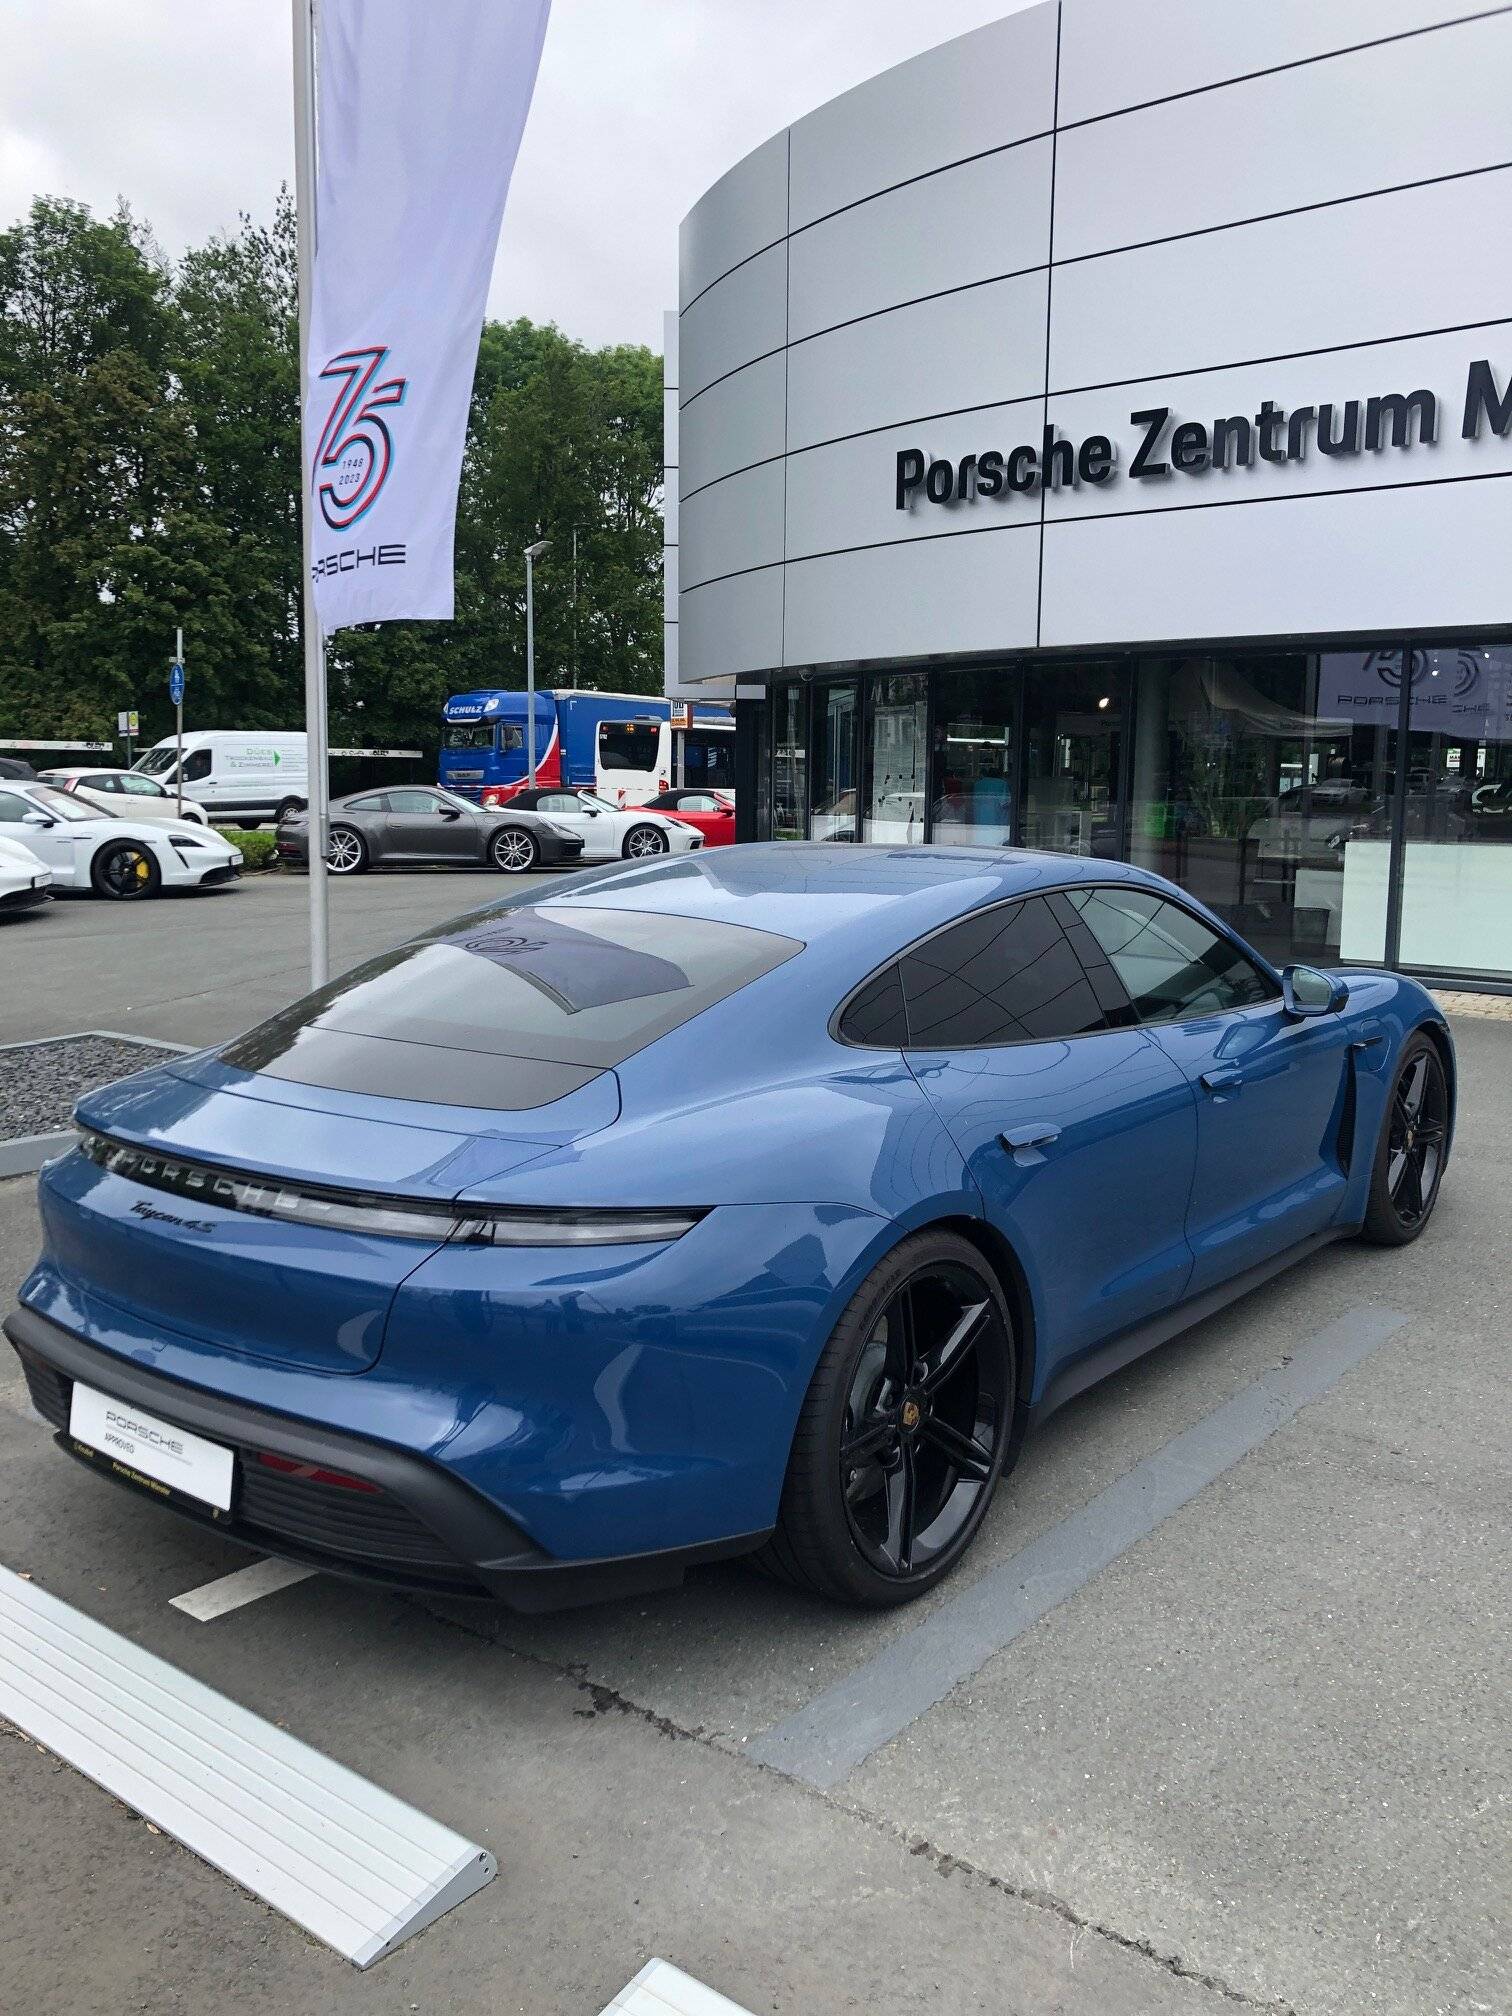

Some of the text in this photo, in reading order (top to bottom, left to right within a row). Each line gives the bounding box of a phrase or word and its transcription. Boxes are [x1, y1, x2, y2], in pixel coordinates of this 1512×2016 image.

[342, 457, 363, 470] 1948
[896, 424, 1112, 511] Porsche
[1128, 387, 1438, 479] Zentrum
[338, 473, 361, 486] 2023
[449, 705, 483, 715] SCHULZ
[120, 1151, 300, 1209] PORSCHE
[130, 1200, 217, 1234] Taycan 4S
[106, 1411, 184, 1454] PORSCHE
